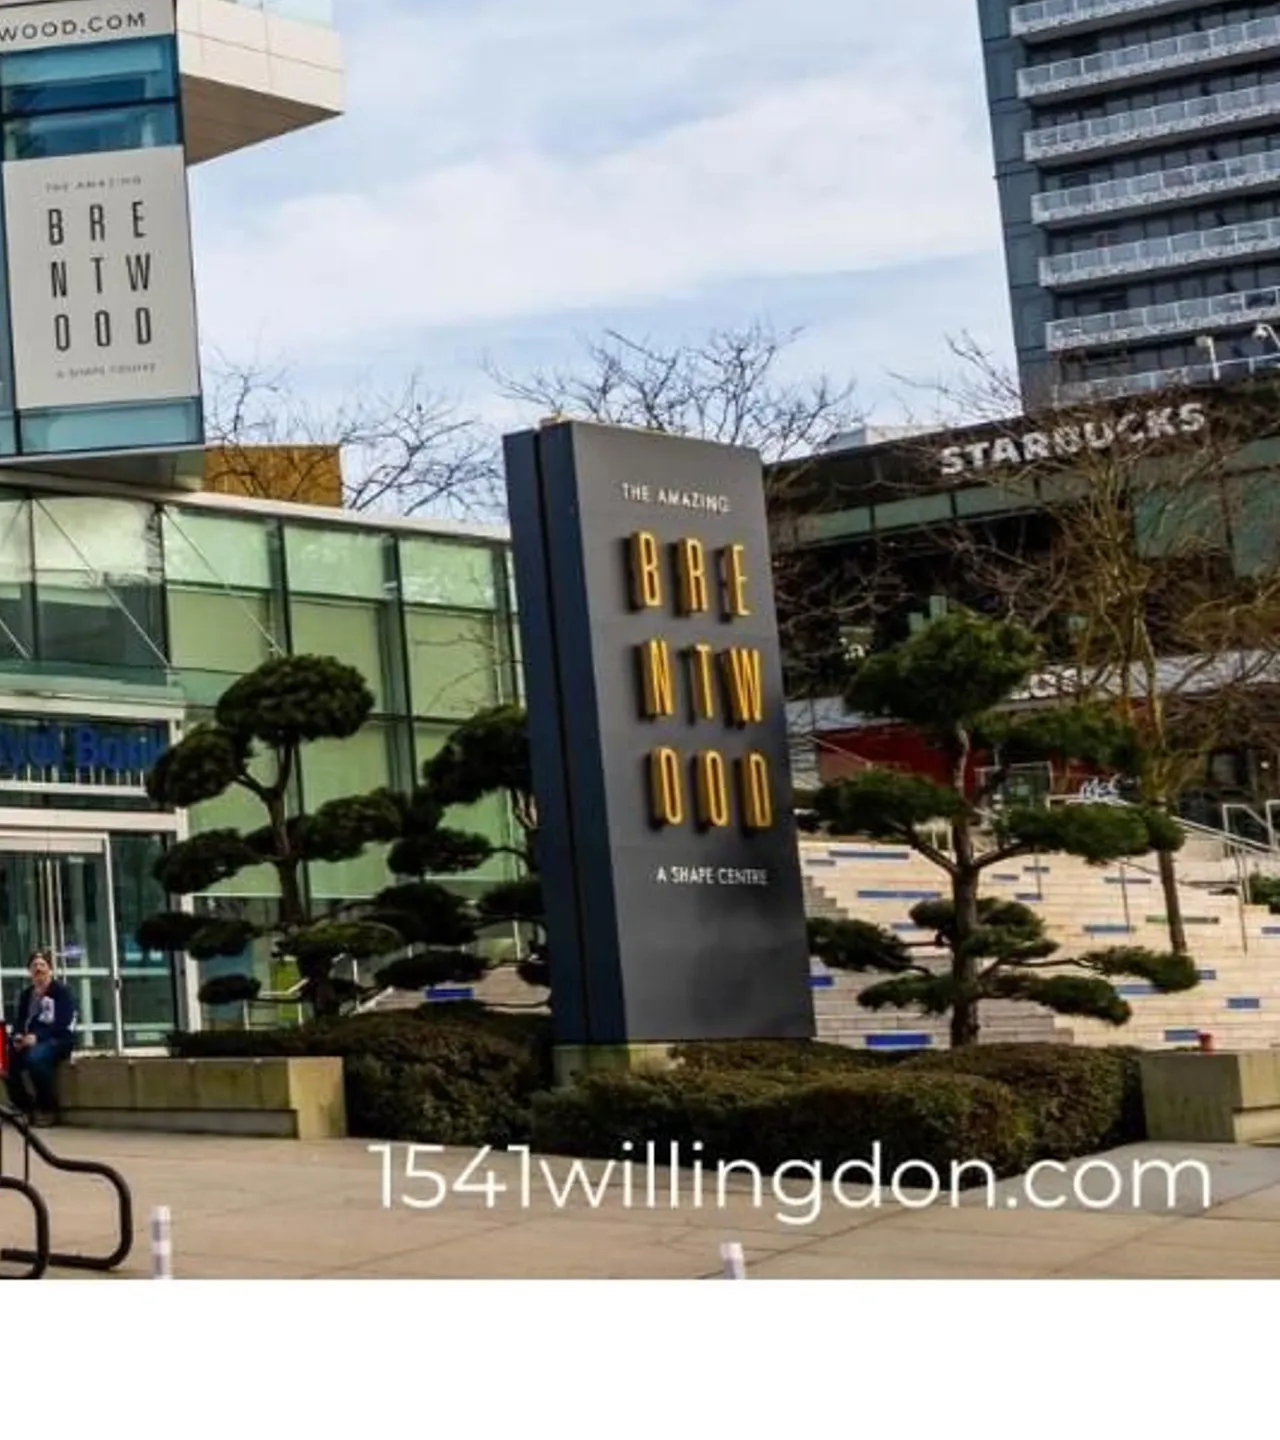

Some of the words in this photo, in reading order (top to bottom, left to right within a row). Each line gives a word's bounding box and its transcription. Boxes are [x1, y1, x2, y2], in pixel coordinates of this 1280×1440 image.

[941, 402, 1206, 475] STARBUCKS
[621, 482, 650, 503] THE
[658, 485, 731, 513] AMAZING
[655, 866, 668, 884] A
[671, 865, 715, 885] SHAPE
[717, 866, 768, 886] CENTRE
